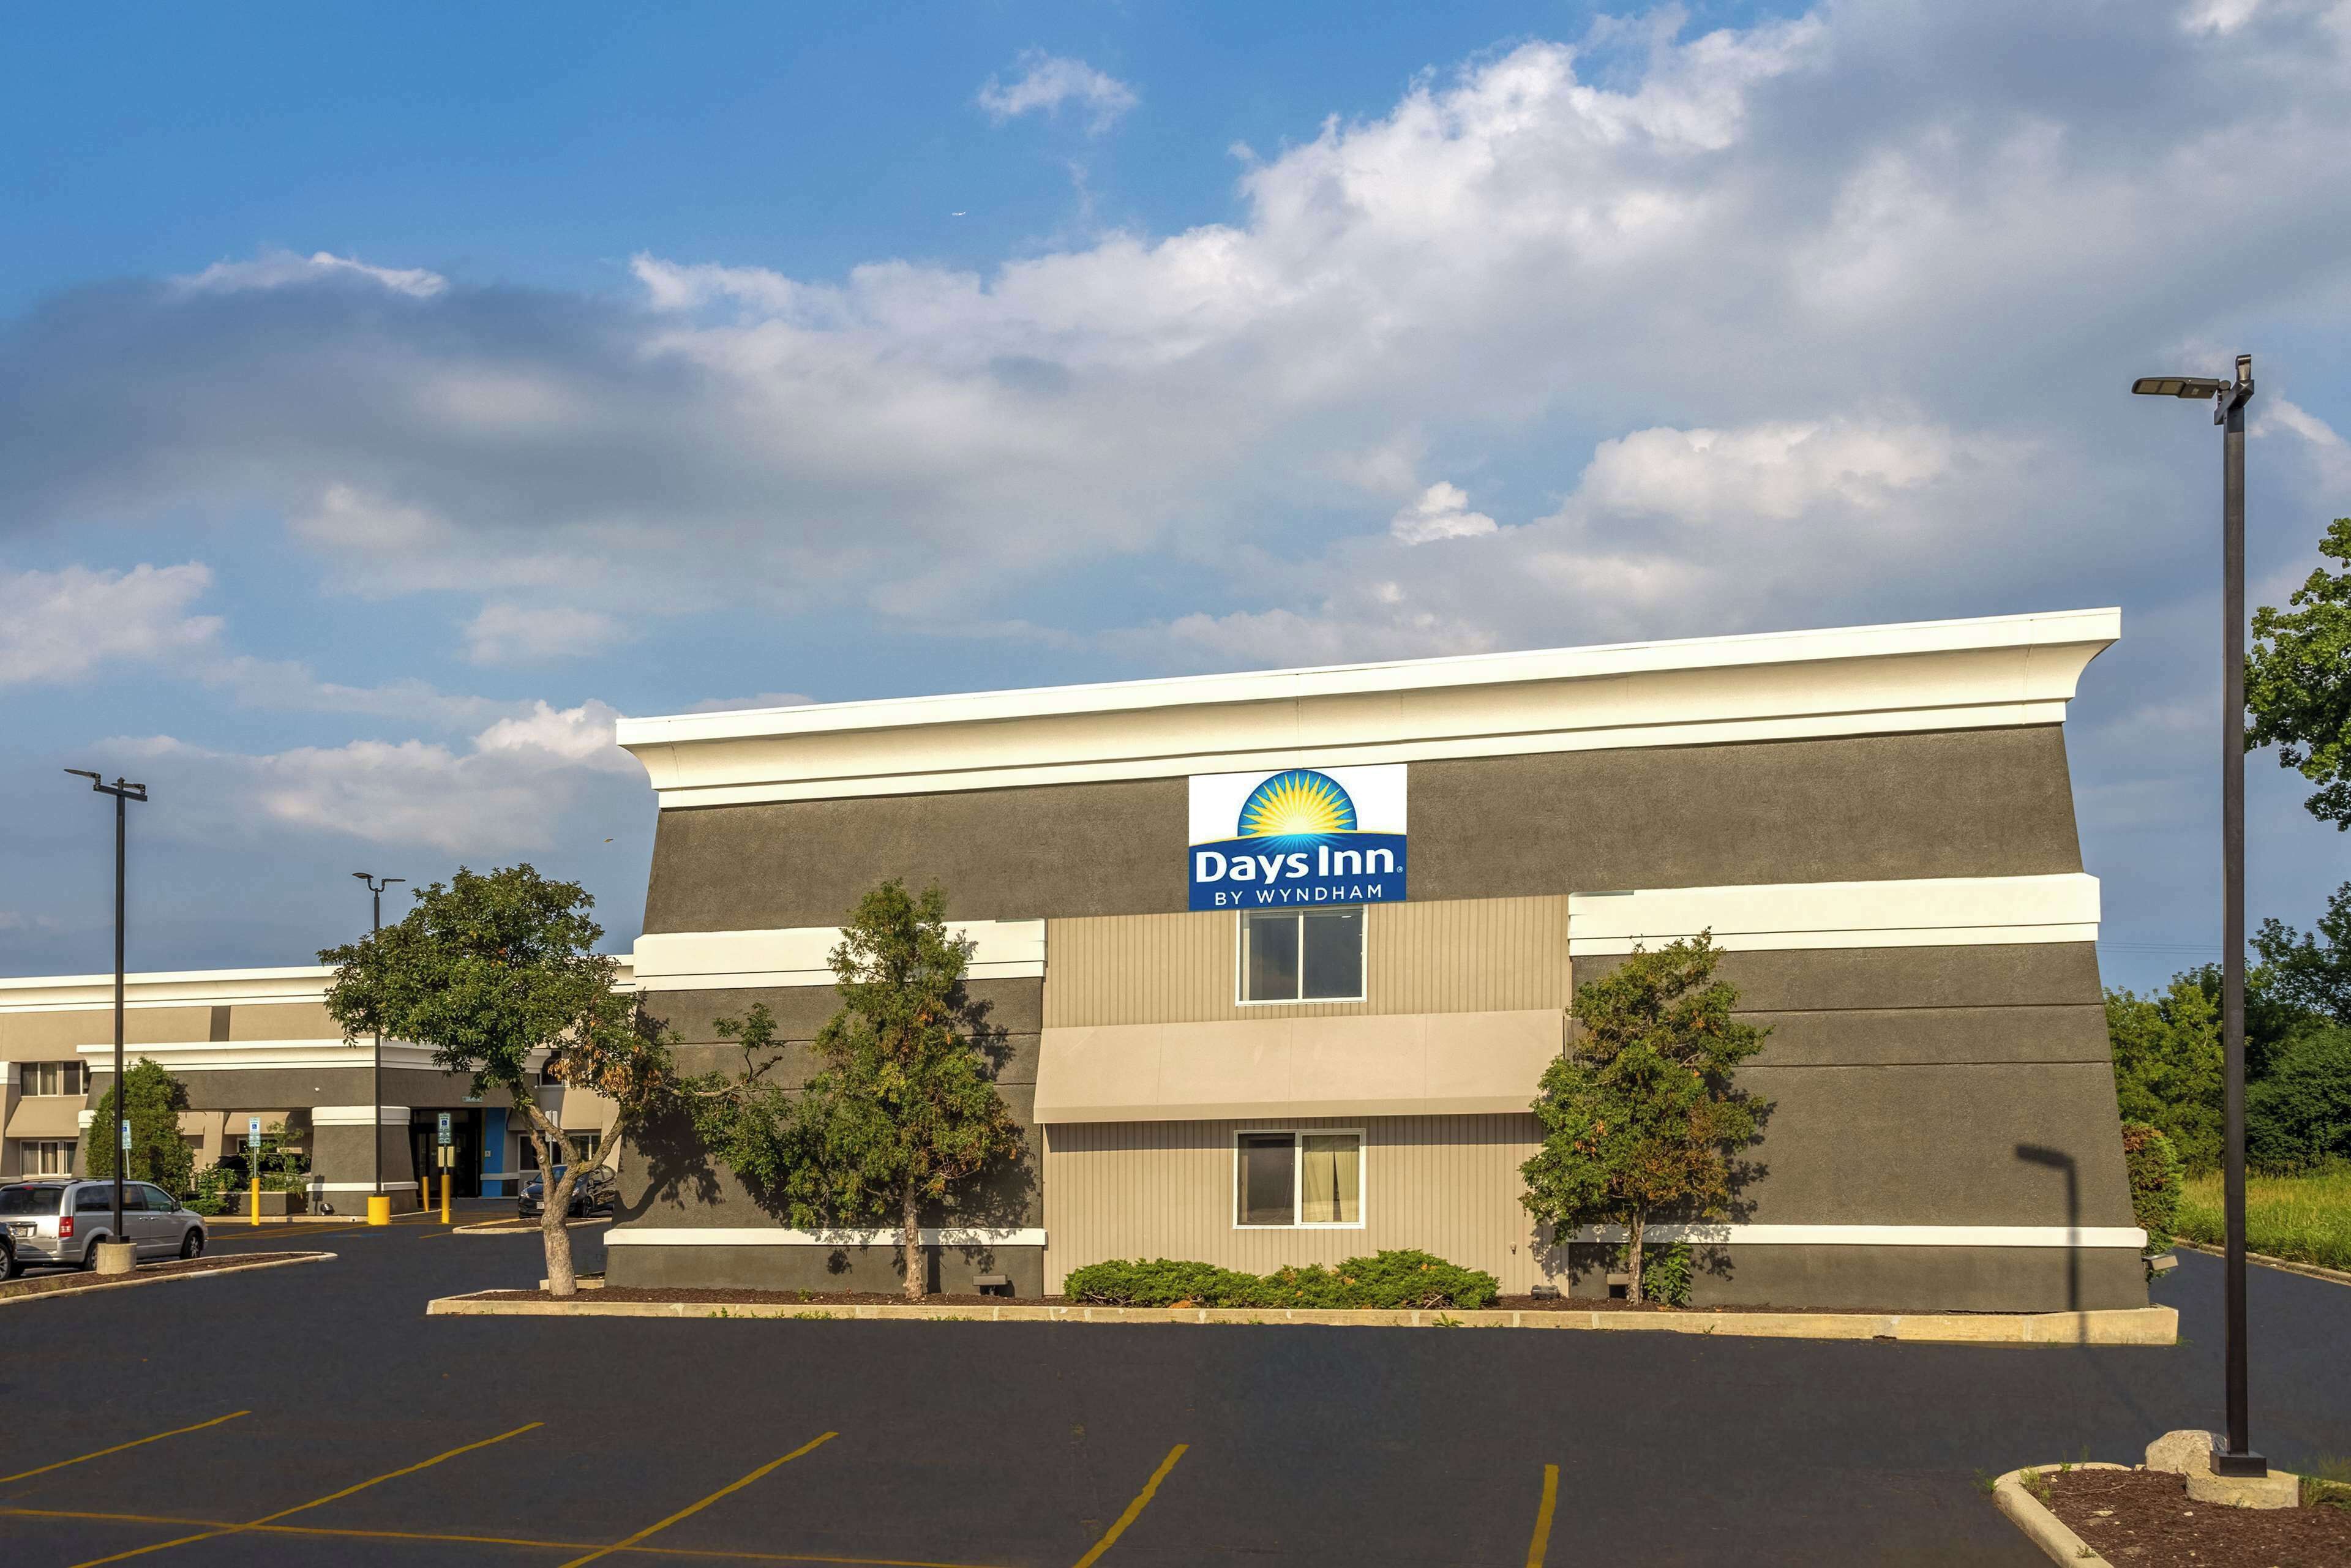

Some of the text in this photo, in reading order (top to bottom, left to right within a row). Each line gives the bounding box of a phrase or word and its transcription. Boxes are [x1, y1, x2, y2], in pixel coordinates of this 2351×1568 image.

[1196, 846, 1394, 884] Days Inn
[1215, 883, 1382, 906] BY WYNDHAM
